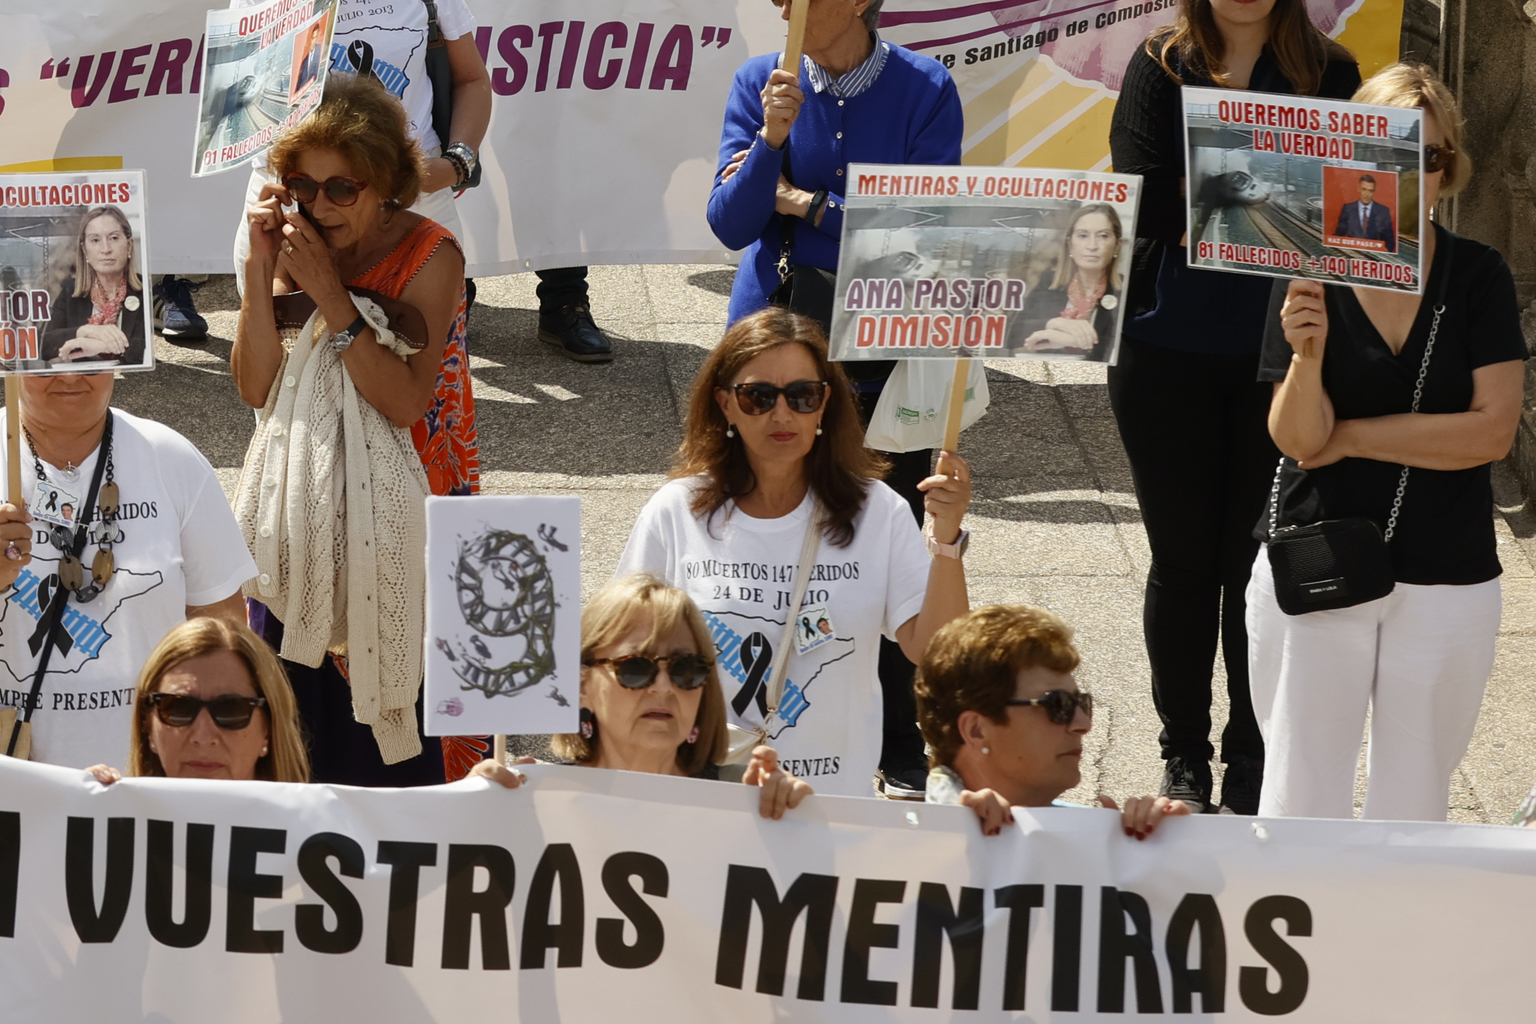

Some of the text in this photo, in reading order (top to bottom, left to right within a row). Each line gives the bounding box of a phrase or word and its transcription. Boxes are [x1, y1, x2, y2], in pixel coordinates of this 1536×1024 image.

[275, 1, 313, 40] VERDAD
[337, 4, 394, 23] JULIO 2013
[964, 27, 1059, 64] Santiago
[1066, 19, 1089, 37] de
[1218, 100, 1389, 138] QUEREMOS SABER
[221, 125, 272, 163] FALLECIDOS
[1252, 129, 1354, 160] LA VERDAD
[857, 174, 1128, 203] MENTIRAS OCULTACIONES
[1198, 242, 1413, 283] 81 FALLECIDOS HERIDOS
[845, 278, 1025, 310] ANA PASTOR
[855, 310, 1007, 348] DIMISIÓN
[686, 559, 793, 583] 80 MUERTOS 147
[714, 585, 764, 603] 24 DE
[65, 815, 670, 971] VUESTRAS
[715, 863, 1314, 1017] MENTIRAS
